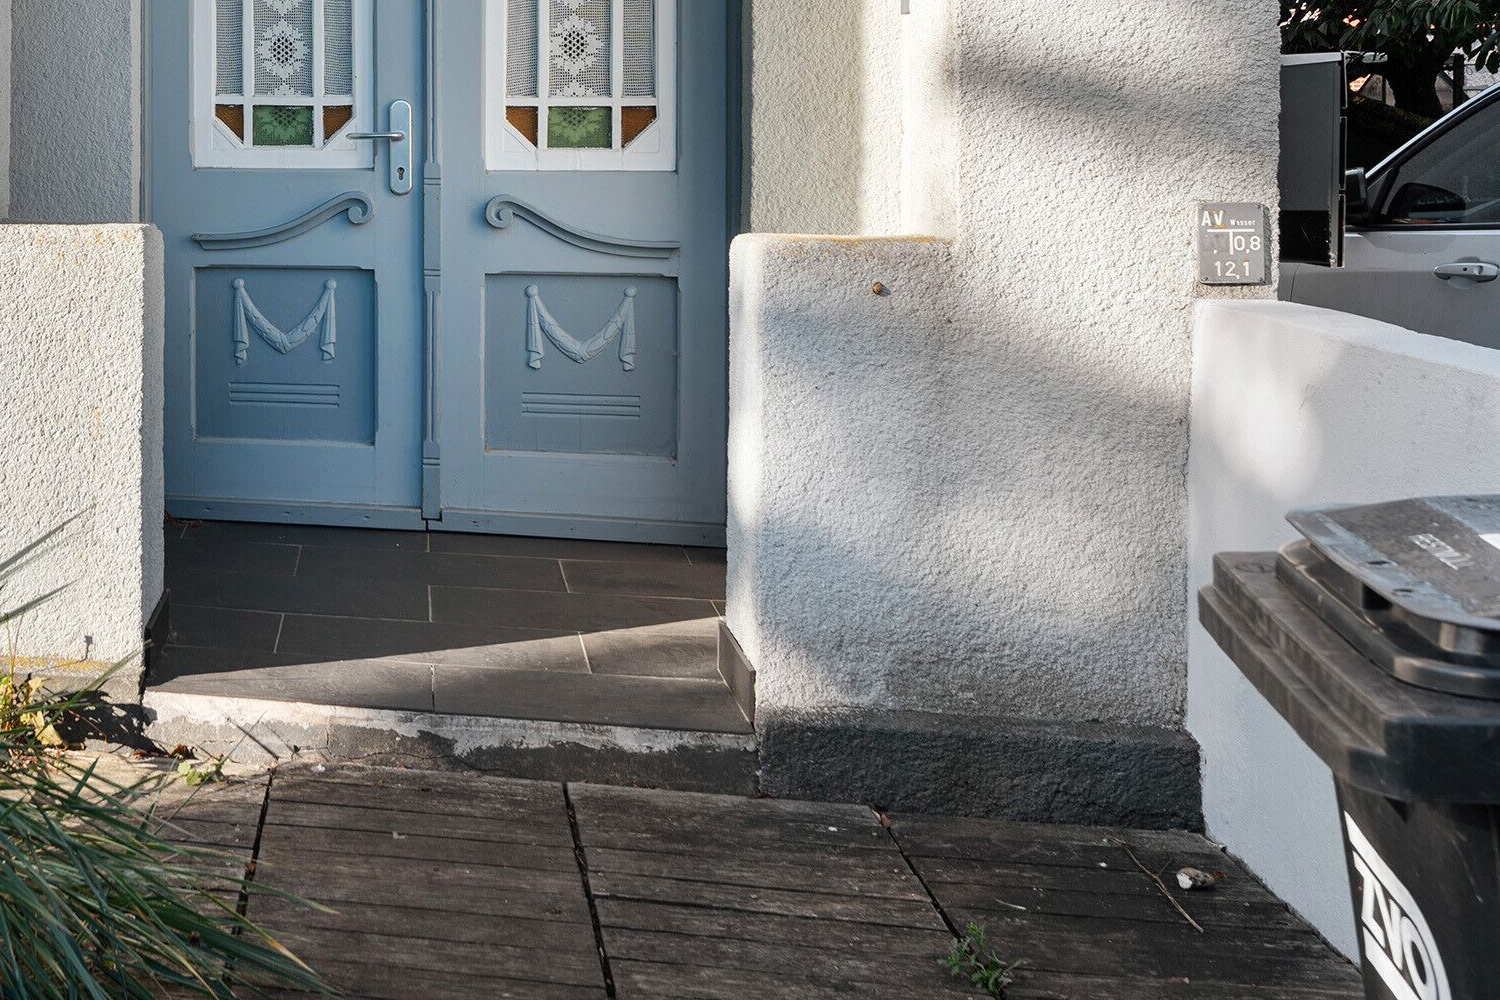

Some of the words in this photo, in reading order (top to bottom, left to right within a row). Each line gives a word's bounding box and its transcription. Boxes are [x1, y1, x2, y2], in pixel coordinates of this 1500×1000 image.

[1201, 210, 1224, 227] AV
[1233, 235, 1261, 254] 0,8
[1214, 260, 1250, 280] 12,1
